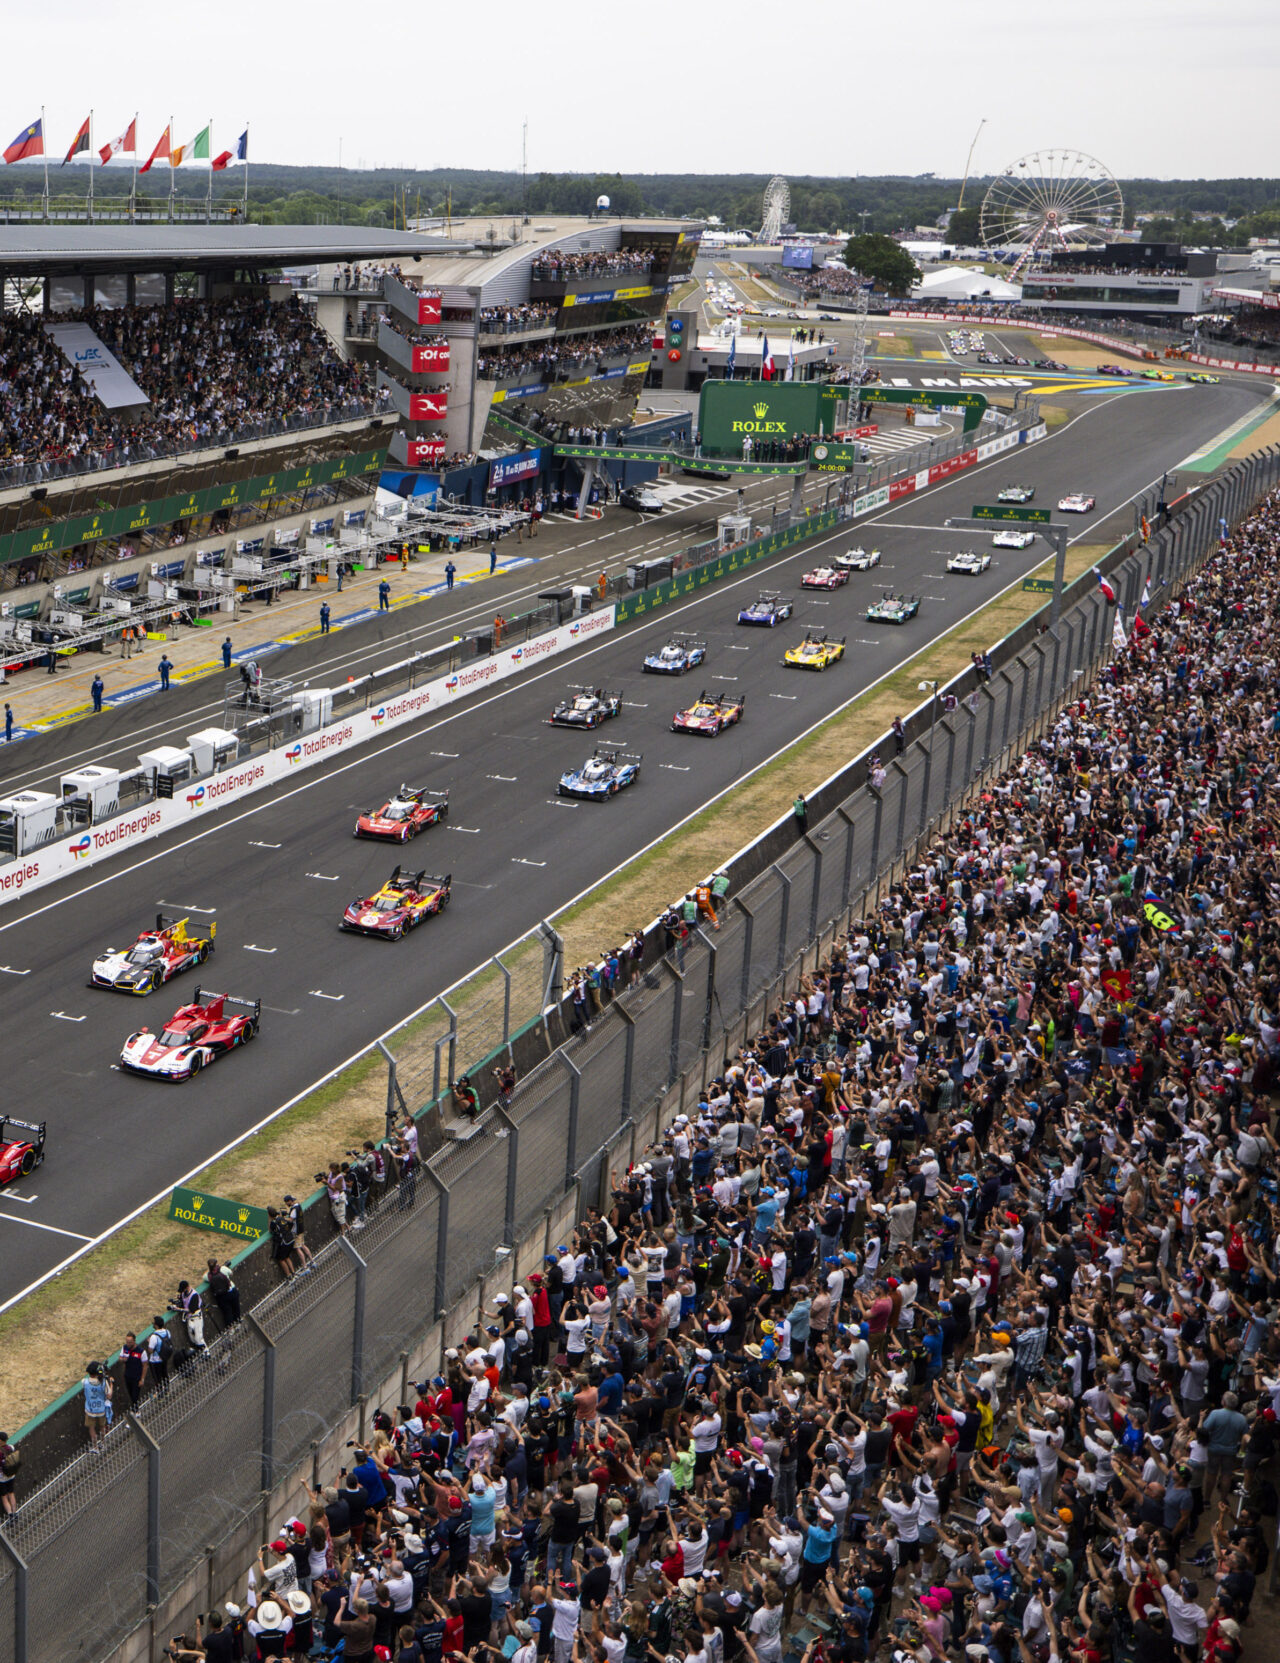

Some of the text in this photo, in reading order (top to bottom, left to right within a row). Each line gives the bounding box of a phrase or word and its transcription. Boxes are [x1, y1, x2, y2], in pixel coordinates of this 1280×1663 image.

[75, 349, 102, 361] WEC
[921, 377, 1033, 387] MANS
[732, 421, 787, 433] ROLEX
[818, 464, 846, 472] 24:00:00
[32, 540, 54, 553] ROLEX
[523, 637, 558, 660] TotalEnergies
[459, 662, 497, 686] TotalEnergies
[386, 693, 430, 720] TotalEnergies
[303, 726, 353, 756] TotalEnergies
[206, 764, 265, 800] TotalEnergies
[93, 810, 161, 849] TotalEnergies
[174, 1207, 262, 1239] ROLEX ROLEX
